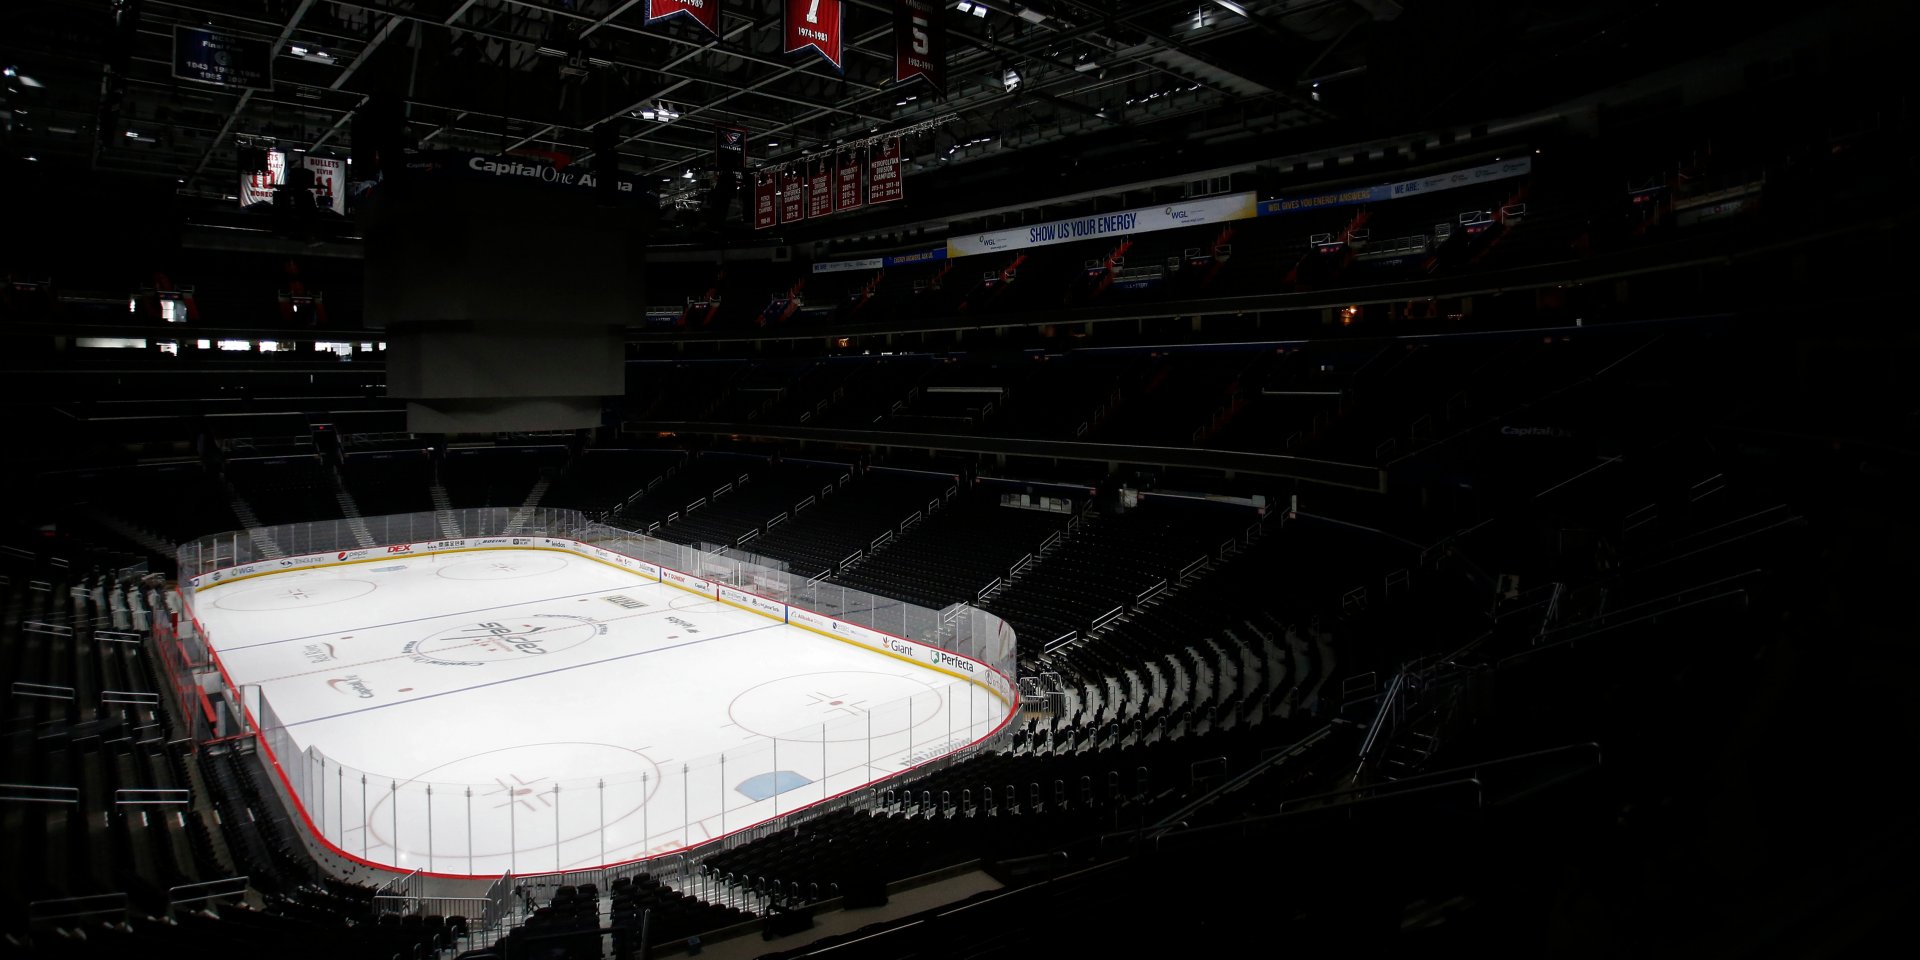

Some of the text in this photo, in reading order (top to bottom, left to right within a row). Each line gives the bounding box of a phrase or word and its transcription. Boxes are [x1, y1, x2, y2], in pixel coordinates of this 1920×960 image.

[798, 26, 829, 42] 1974-1981
[912, 16, 929, 55] 5
[310, 158, 339, 168] BULLETS
[871, 157, 899, 168] METROPOLITAN
[876, 165, 893, 174] DIVISION
[874, 172, 896, 181] CHAMPIONS
[1394, 185, 1404, 195] WE
[1282, 200, 1299, 211] GIVES
[1300, 198, 1312, 208] YOU
[1313, 194, 1337, 206] ENERGY
[1339, 190, 1370, 202] ANSWERS
[1171, 211, 1189, 220] WGL
[1030, 212, 1137, 243] SHOW US YOUR ENERGY
[387, 545, 412, 553] DEX
[552, 541, 565, 549] leidos
[349, 550, 368, 559] pepsi
[239, 565, 255, 574] WGL
[890, 639, 914, 656] Giant
[941, 653, 975, 673] Perfecta
